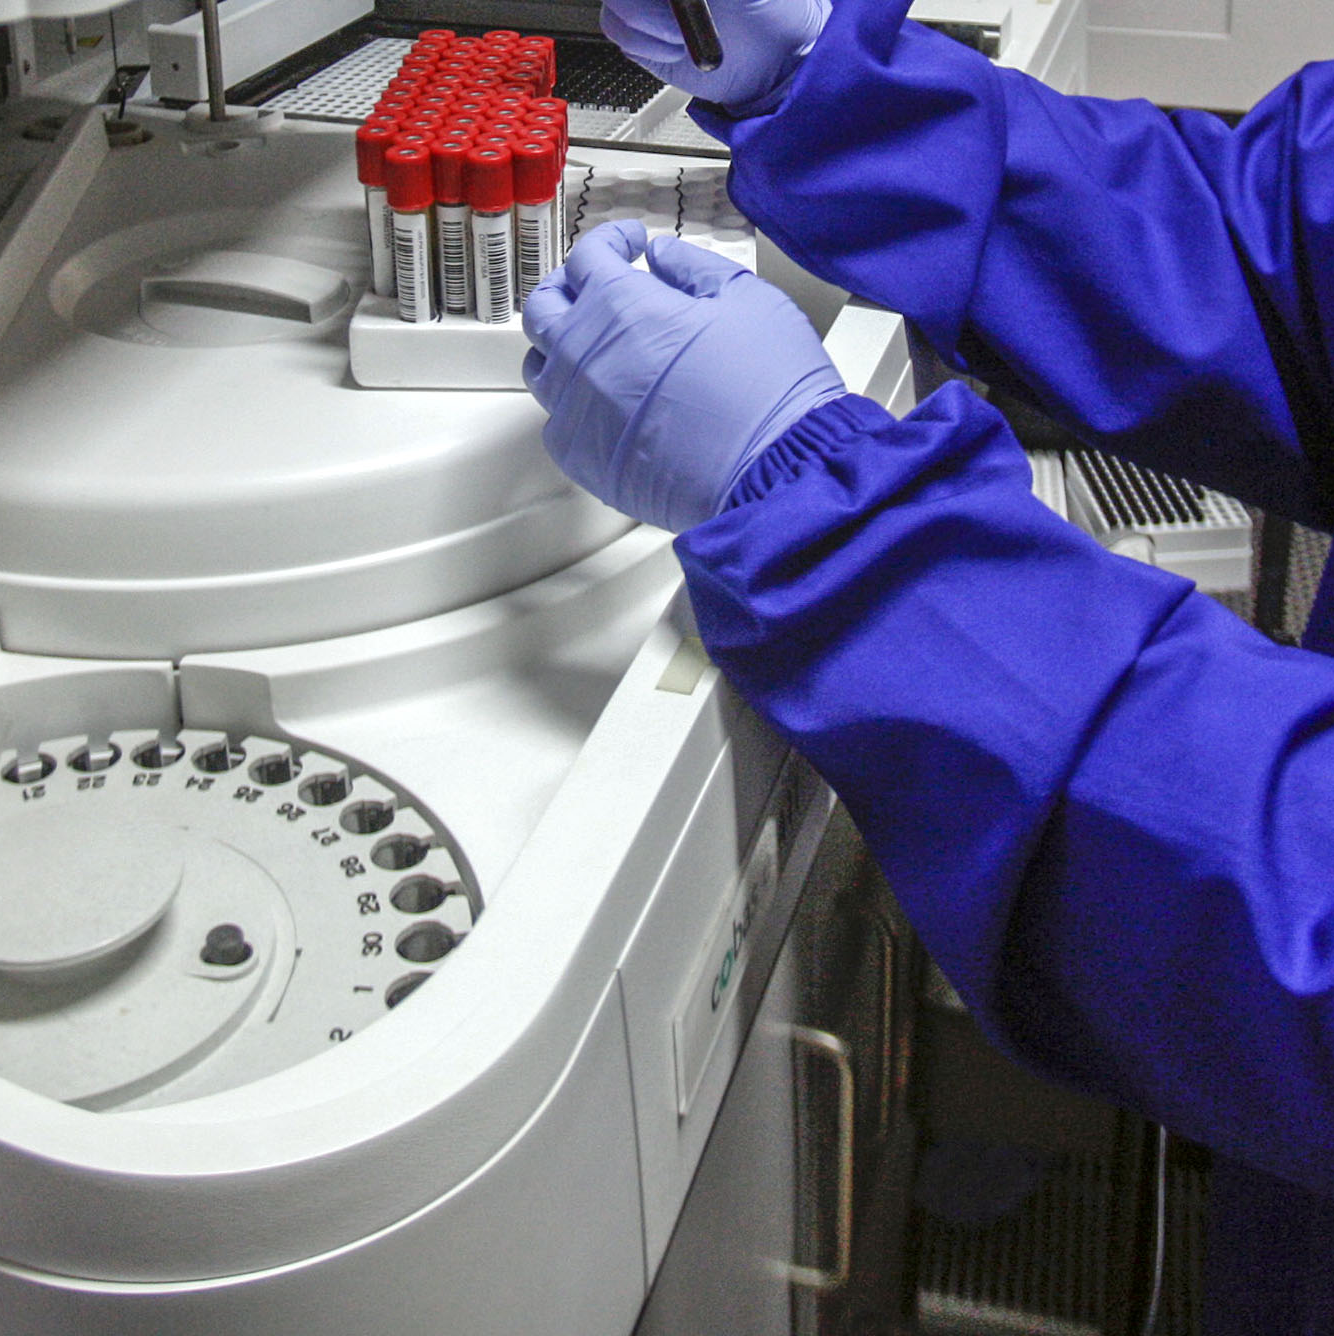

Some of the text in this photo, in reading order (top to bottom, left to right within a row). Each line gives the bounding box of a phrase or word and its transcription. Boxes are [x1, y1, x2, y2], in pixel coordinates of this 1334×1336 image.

[77, 775, 107, 791] 22
[132, 773, 162, 786] 23
[185, 775, 215, 791] 24
[22, 785, 46, 801] 21
[277, 802, 307, 821] 26
[311, 827, 341, 846] 27
[340, 855, 366, 878] 28
[357, 892, 381, 915] 29
[362, 932, 383, 957] 30
[353, 986, 373, 994] 1
[329, 1027, 353, 1042] 2
